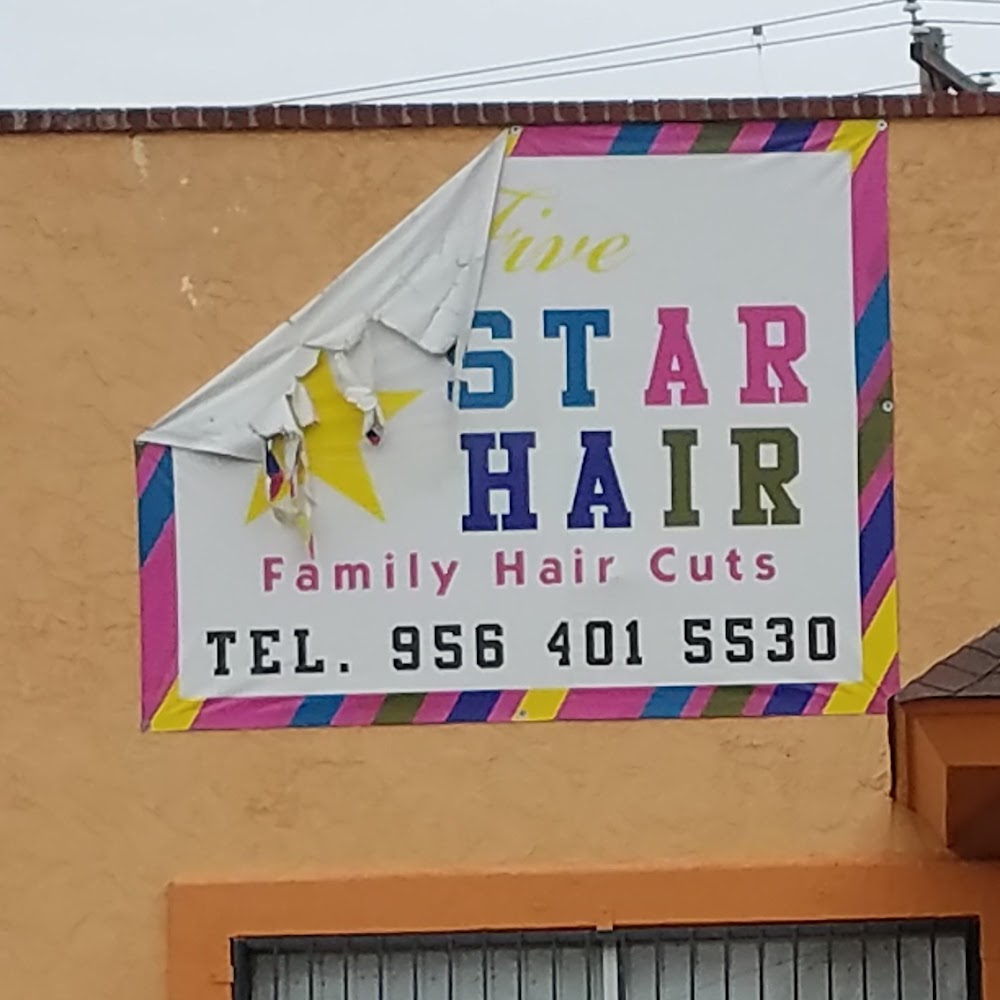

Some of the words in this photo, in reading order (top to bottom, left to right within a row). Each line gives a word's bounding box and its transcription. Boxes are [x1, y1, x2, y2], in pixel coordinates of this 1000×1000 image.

[448, 305, 808, 409] STAR
[461, 428, 801, 531] HAIR
[262, 550, 459, 596] Family
[496, 548, 615, 586] Hair
[649, 545, 778, 583] Cuts
[206, 628, 351, 677] TEL.
[391, 623, 506, 670] 956
[547, 619, 643, 667] 401
[683, 615, 837, 663] 5530
